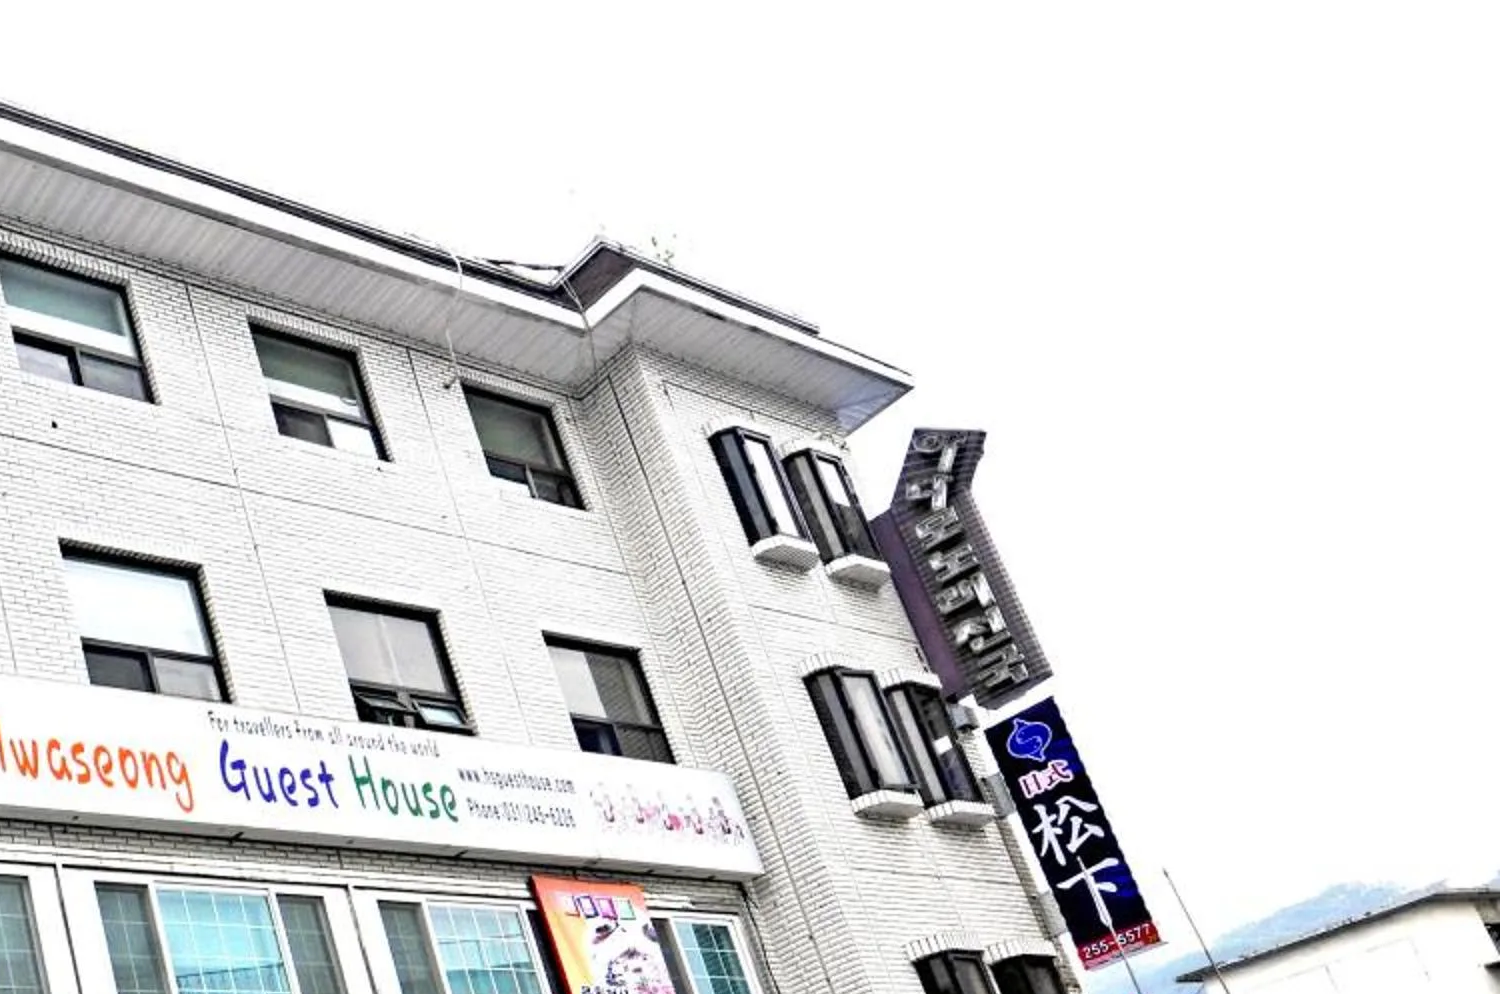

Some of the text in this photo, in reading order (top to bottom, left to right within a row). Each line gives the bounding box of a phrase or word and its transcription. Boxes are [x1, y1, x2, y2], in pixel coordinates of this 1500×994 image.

[388, 734, 407, 754] the
[412, 740, 440, 758] world
[219, 739, 339, 808] Guest
[348, 754, 459, 822] House
[1017, 758, 1075, 800] 日式
[1032, 795, 1120, 930] 松下
[1082, 922, 1152, 959] 255-5577
